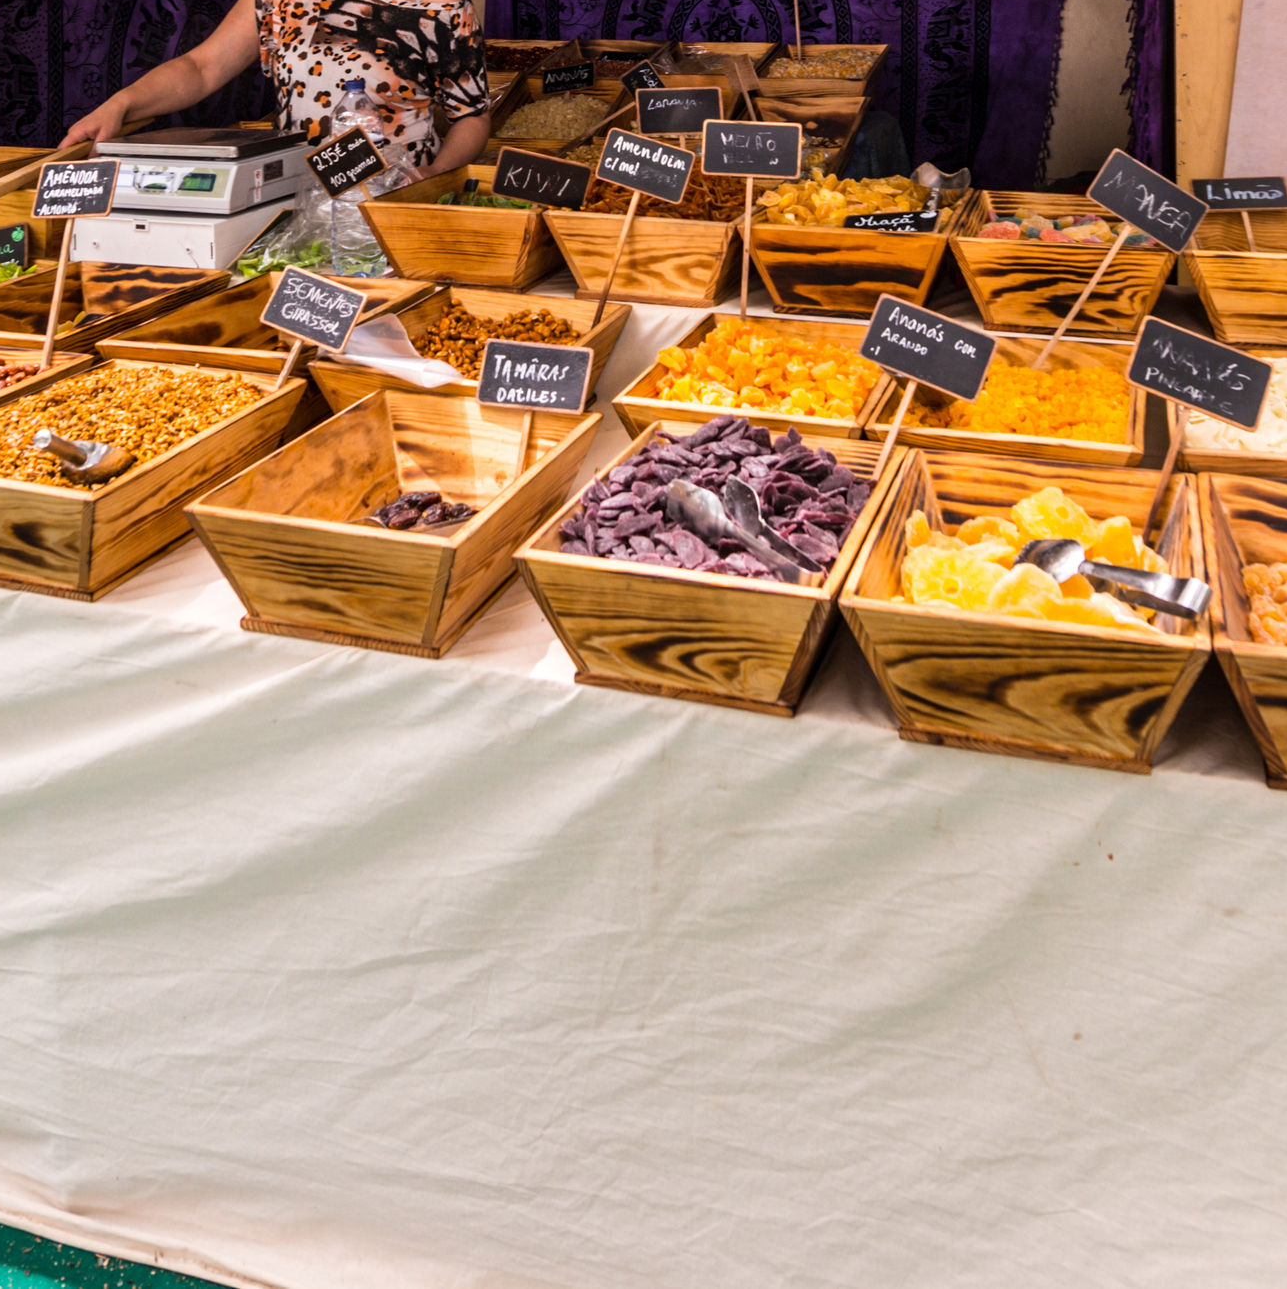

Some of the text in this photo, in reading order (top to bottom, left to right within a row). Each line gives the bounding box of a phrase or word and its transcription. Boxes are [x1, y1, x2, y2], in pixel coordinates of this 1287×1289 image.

[613, 135, 686, 171] Amendoim
[330, 172, 347, 189] 100
[888, 306, 945, 343] Ananás
[880, 327, 929, 356] ARANDO
